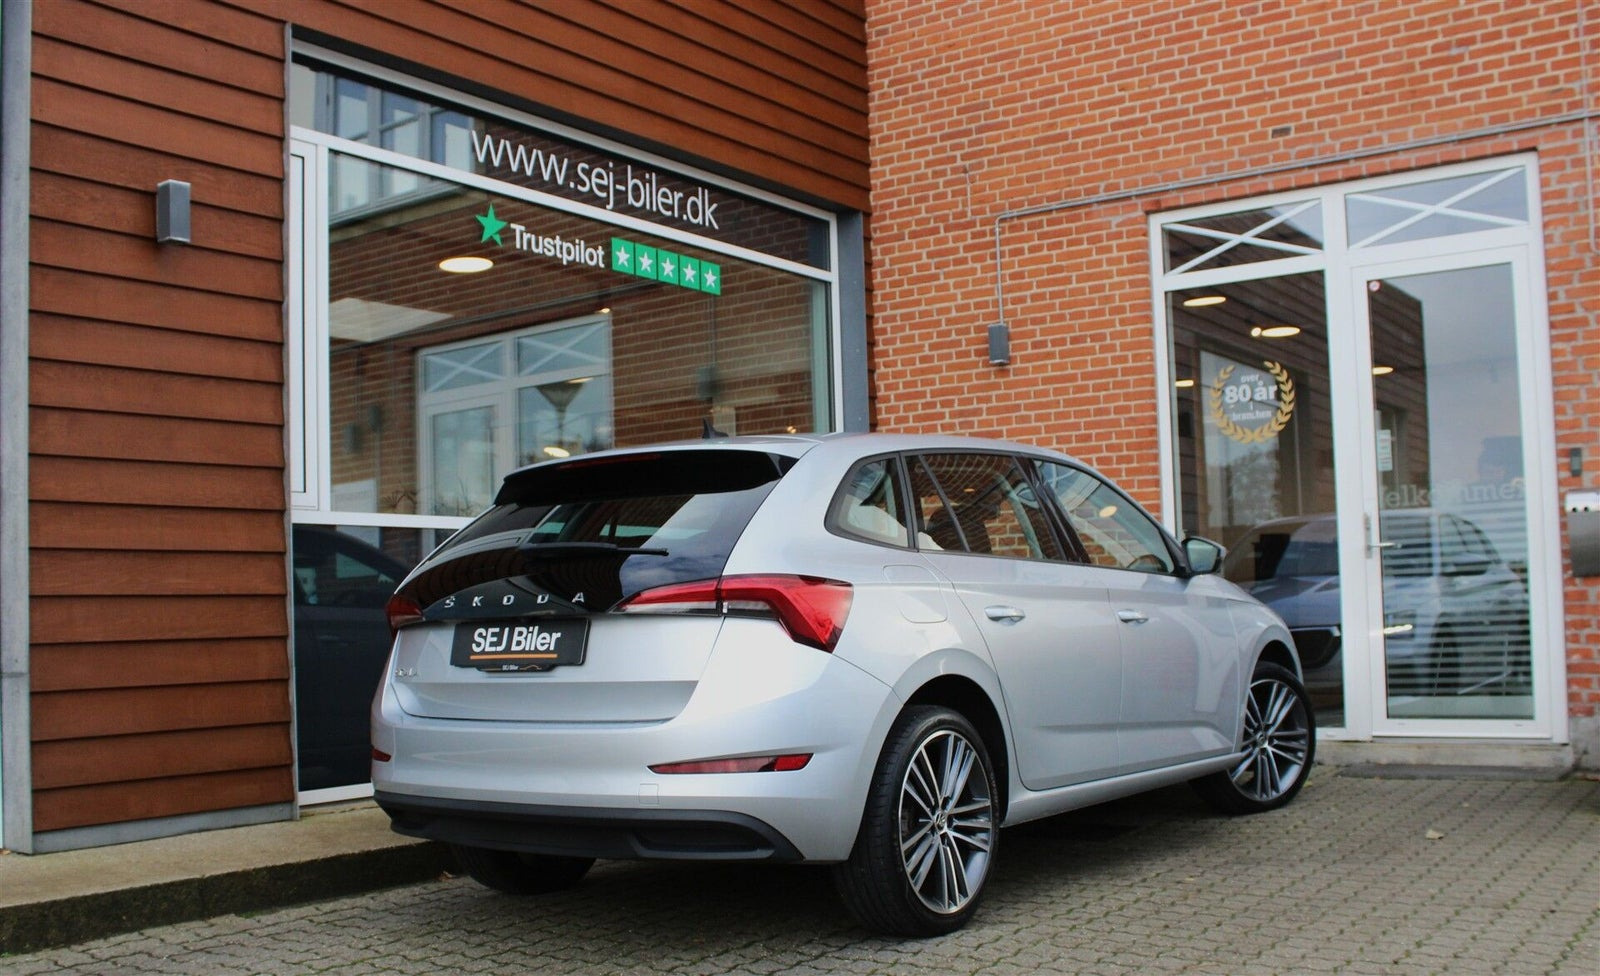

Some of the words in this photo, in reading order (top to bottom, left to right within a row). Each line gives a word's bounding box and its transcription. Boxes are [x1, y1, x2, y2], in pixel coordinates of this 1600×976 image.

[471, 129, 719, 230] www.sej-biler.dk
[510, 223, 605, 268] Trustpilot
[1241, 374, 1259, 382] over
[1224, 384, 1251, 403] 80
[1253, 381, 1277, 401] år
[472, 627, 507, 653] SEJ
[511, 626, 561, 651] Biler
